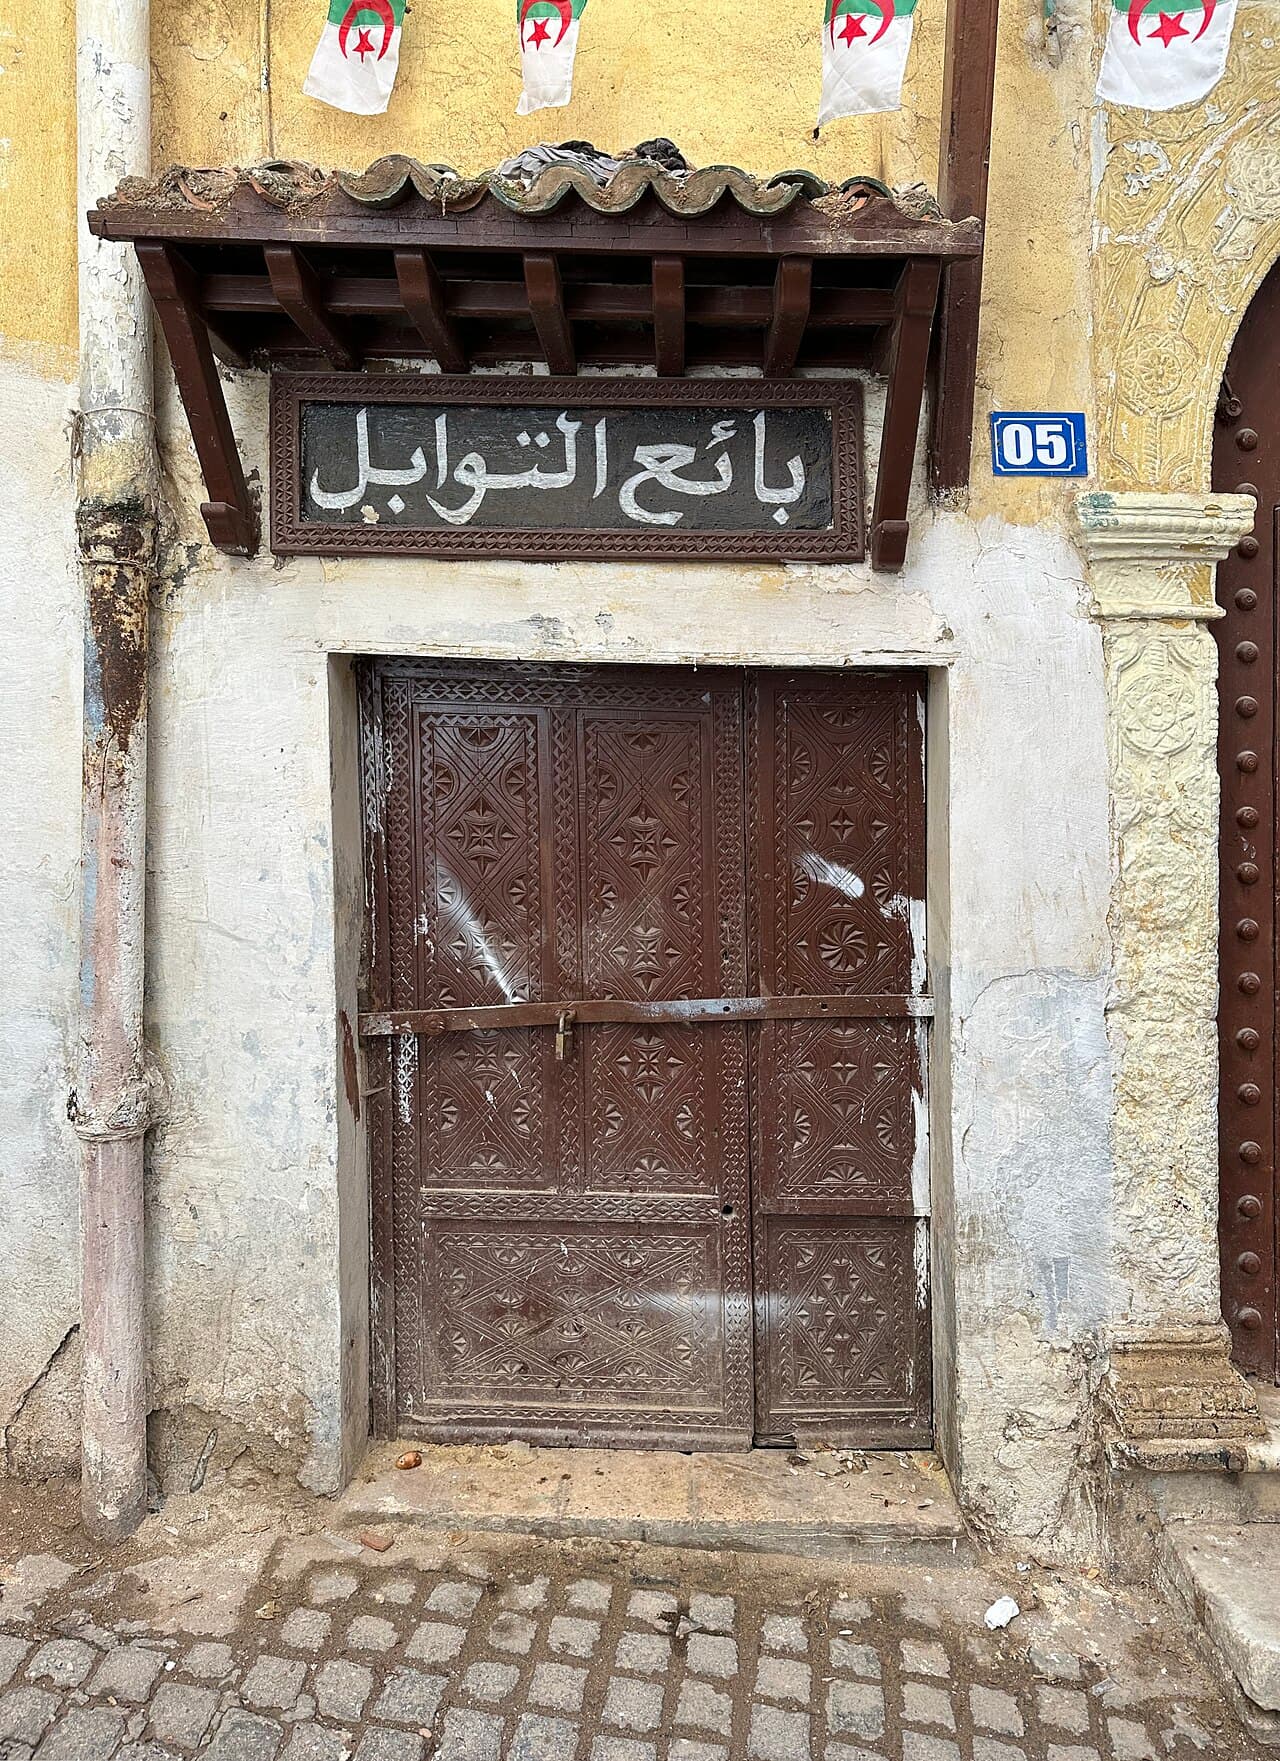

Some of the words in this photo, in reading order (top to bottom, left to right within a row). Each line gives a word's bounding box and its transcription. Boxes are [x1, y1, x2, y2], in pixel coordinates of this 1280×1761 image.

[309, 407, 608, 526] التوابل
[618, 410, 806, 526] بائع
[1002, 423, 1067, 466] 05
